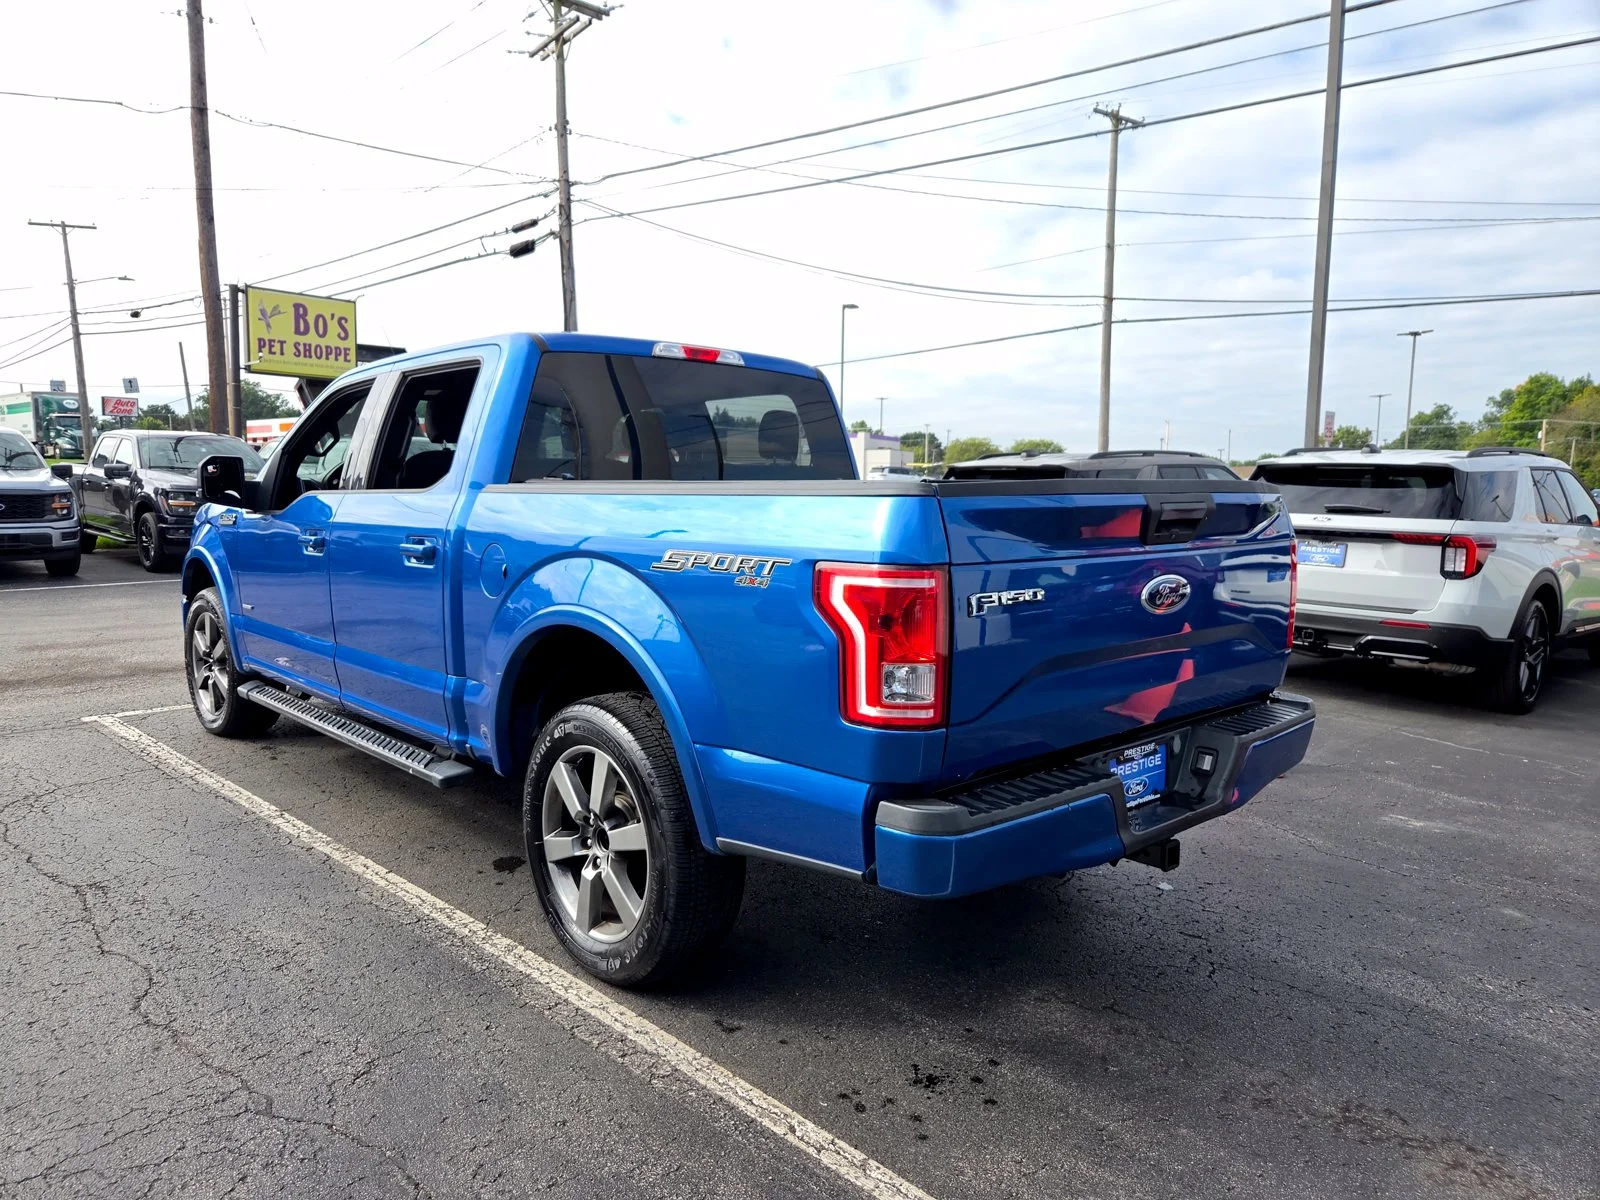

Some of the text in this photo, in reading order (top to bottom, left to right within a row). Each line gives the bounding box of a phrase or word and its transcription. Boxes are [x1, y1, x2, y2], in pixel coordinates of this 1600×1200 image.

[257, 337, 351, 363] PET SHOPPE
[113, 399, 136, 408] Auto
[109, 406, 133, 415] Zone
[1300, 545, 1341, 554] PRESTIGE
[650, 549, 792, 577] SPORT
[1124, 743, 1156, 758] PRESTIGE
